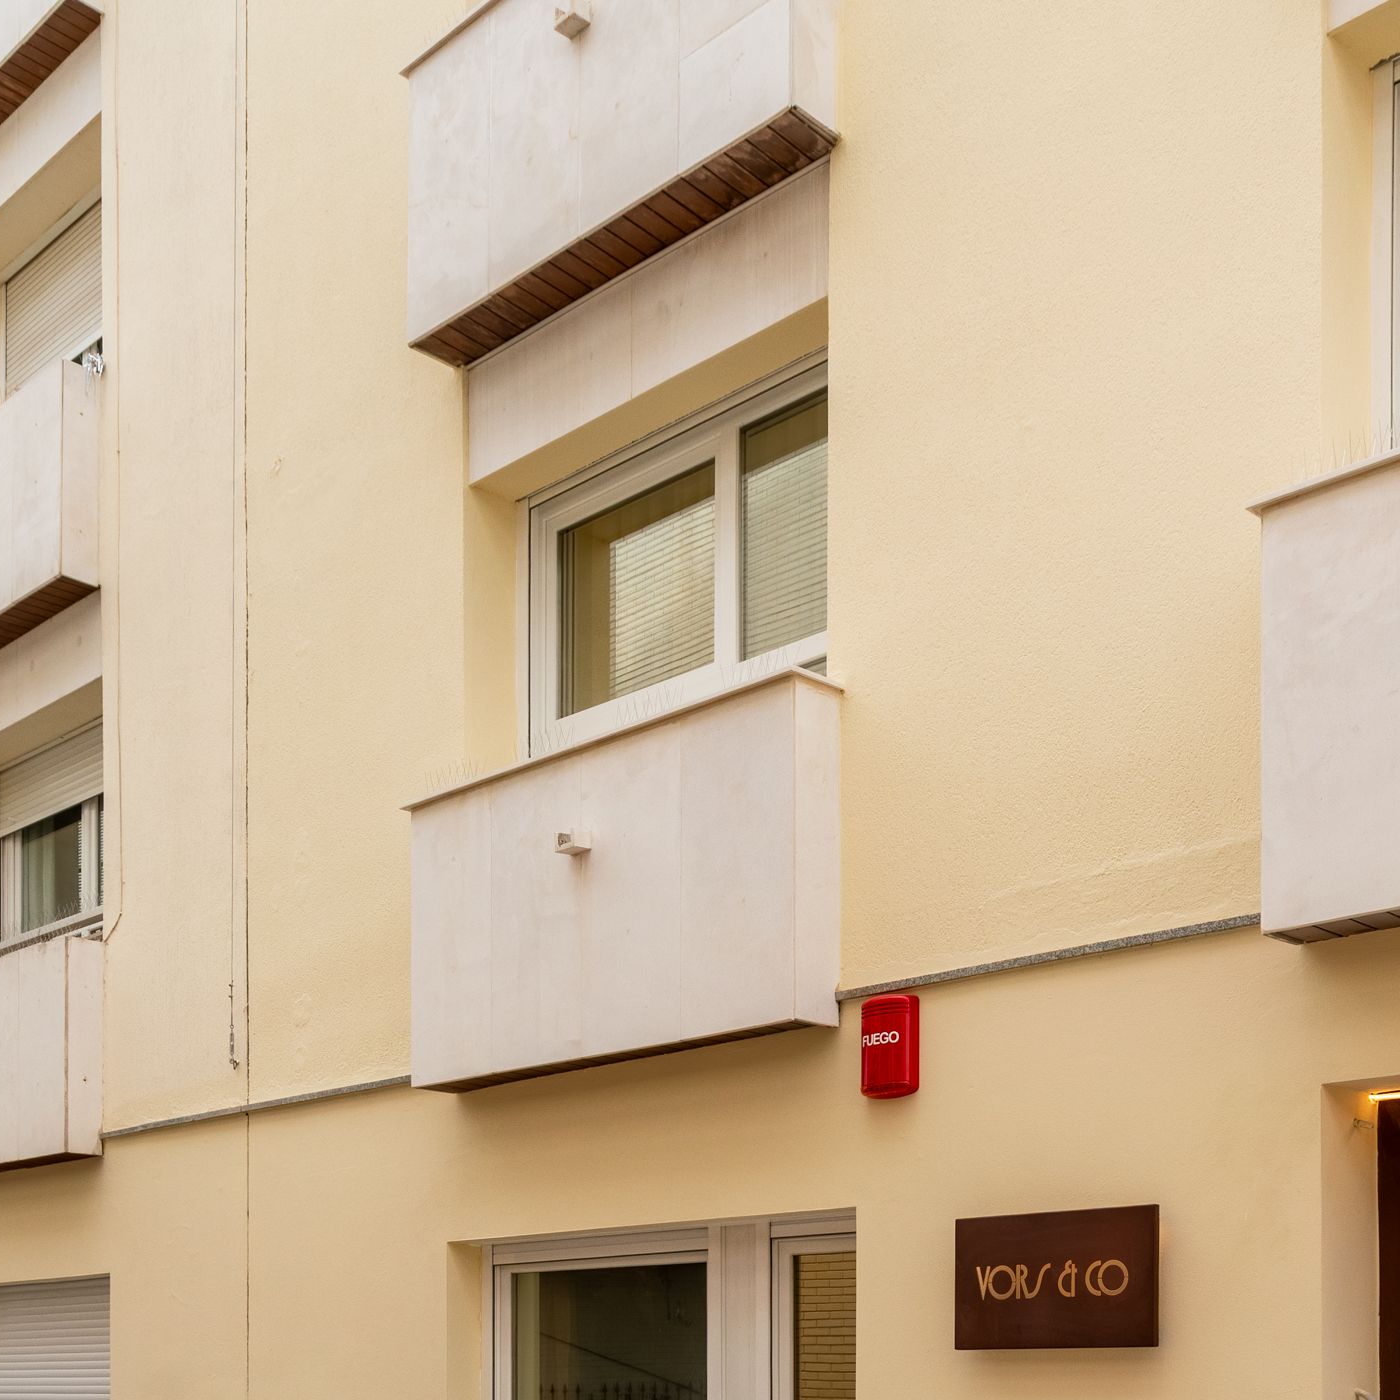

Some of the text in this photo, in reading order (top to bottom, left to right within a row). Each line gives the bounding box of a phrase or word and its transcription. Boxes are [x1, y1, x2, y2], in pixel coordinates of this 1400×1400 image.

[862, 1031, 899, 1048] FUEGO
[976, 1263, 1051, 1300] VORS
[1085, 1259, 1129, 1297] CO
